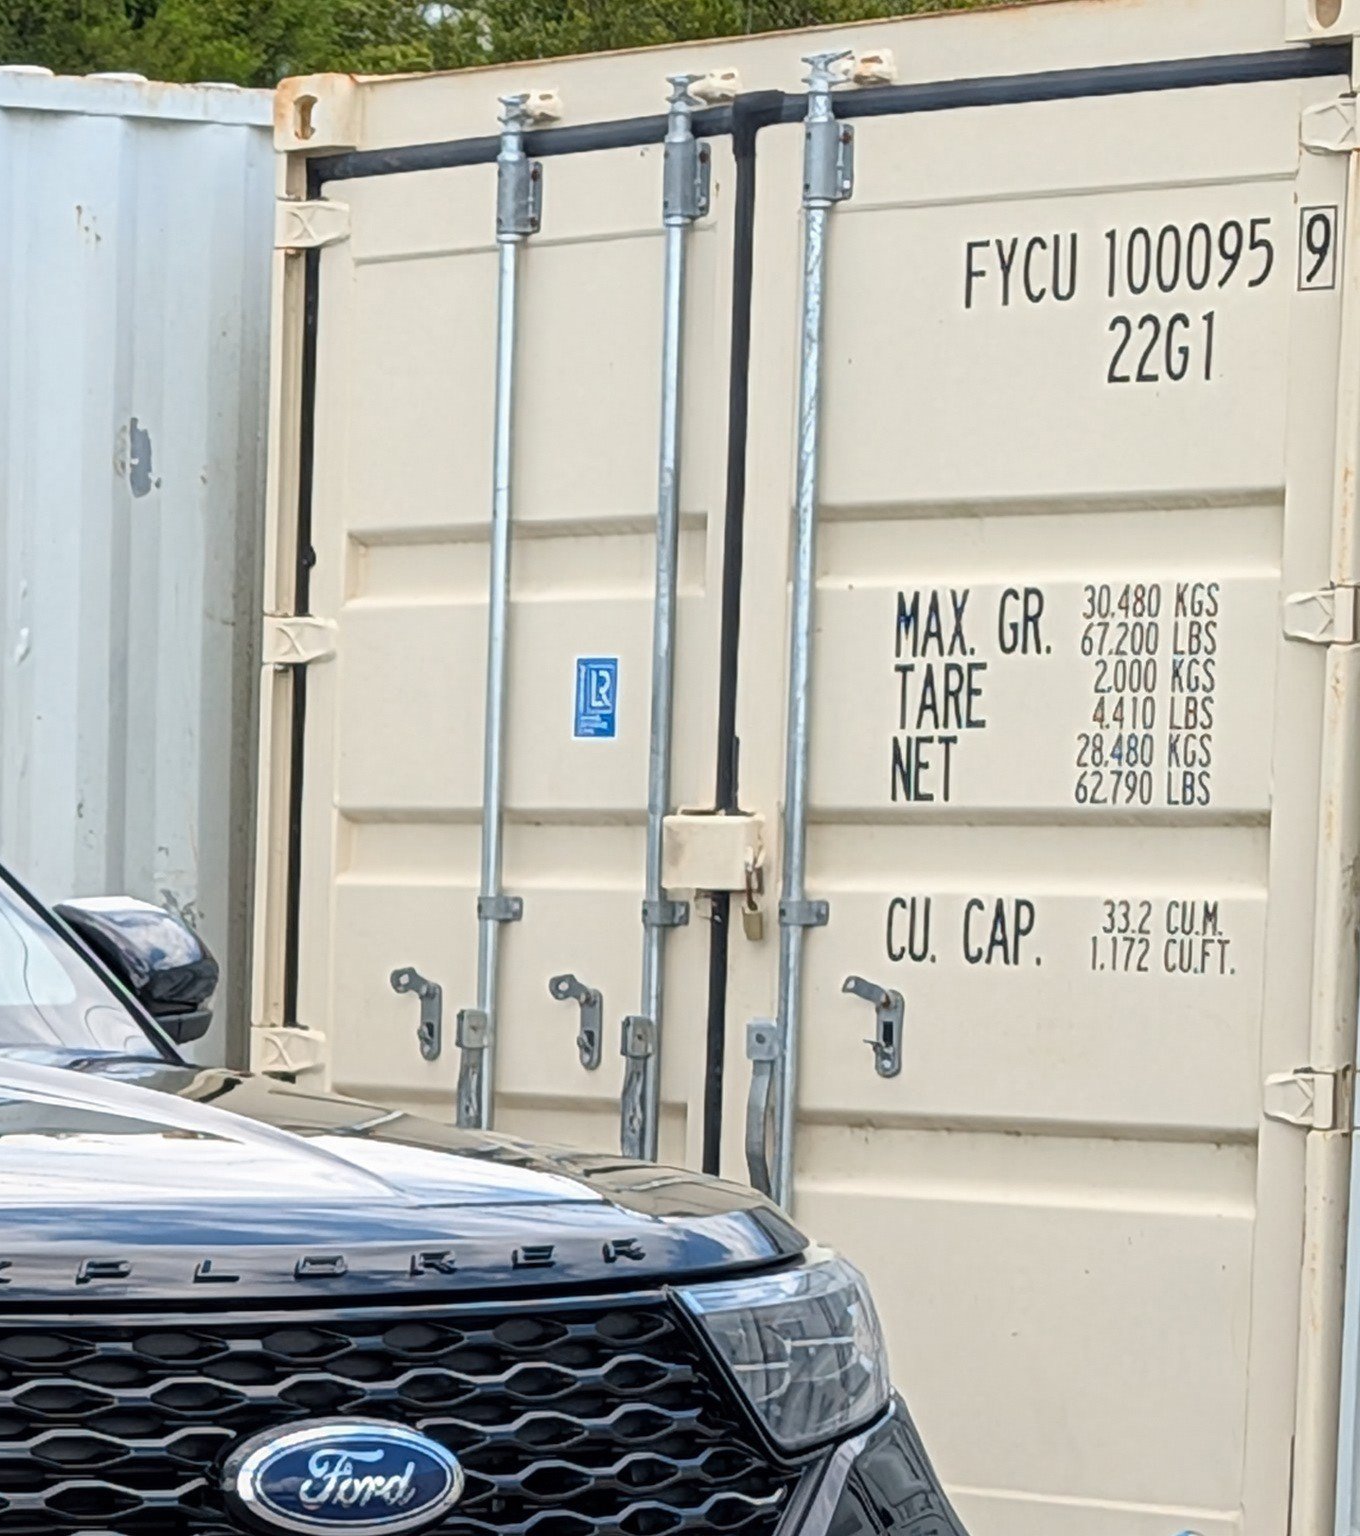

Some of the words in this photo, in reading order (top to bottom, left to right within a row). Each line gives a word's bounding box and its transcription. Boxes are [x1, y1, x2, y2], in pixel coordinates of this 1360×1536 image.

[964, 232, 1078, 310] FYCU
[1104, 217, 1274, 298] 100095
[1305, 213, 1332, 283] 9
[1107, 310, 1215, 384] 22G1
[1174, 582, 1220, 619] KGS
[894, 588, 976, 659] MAX.
[998, 586, 1052, 655] GR.
[1172, 620, 1218, 656] LBS
[1170, 657, 1216, 694] KGS
[893, 661, 988, 730] TARE
[1168, 695, 1215, 731] LBS
[890, 734, 958, 803] NET
[1167, 732, 1213, 768] KGS
[1166, 770, 1211, 806] LBS
[886, 896, 937, 964] CU.
[962, 897, 1042, 967] CAP.
[1102, 899, 1152, 936] 33.2
[1091, 935, 1150, 973] 1.172
[299, 1448, 416, 1507] Ford
